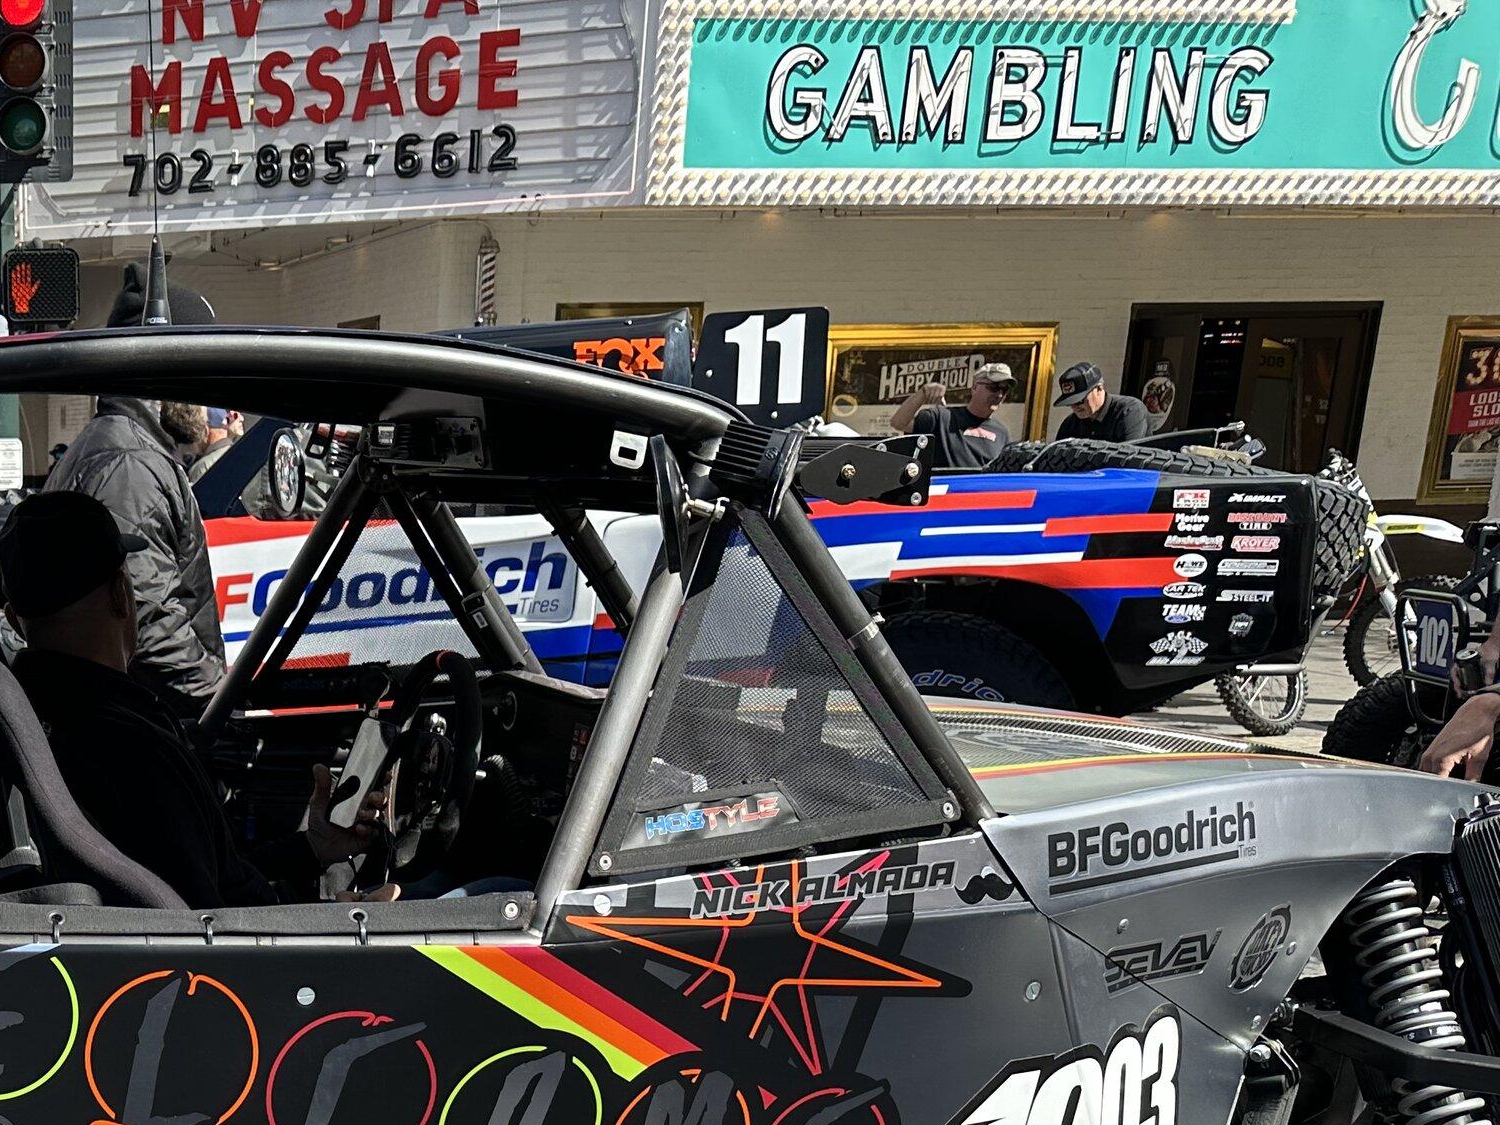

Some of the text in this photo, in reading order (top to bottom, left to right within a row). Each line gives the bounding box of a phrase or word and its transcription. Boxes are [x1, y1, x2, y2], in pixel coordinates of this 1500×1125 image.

[130, 28, 521, 138] MASSAGE
[764, 44, 1275, 145] GAMBLING
[122, 124, 519, 197] 702-885-6612
[724, 313, 806, 405] 11
[879, 363, 935, 400] HAPPY
[907, 358, 961, 373] DOUBLE
[1469, 391, 1500, 407] LOO
[518, 597, 560, 617] Tires
[1418, 614, 1449, 668] 102
[645, 796, 781, 840] HOSTYLE
[1047, 800, 1257, 879] BFGoodrich
[689, 859, 958, 920] NICK ALMADA
